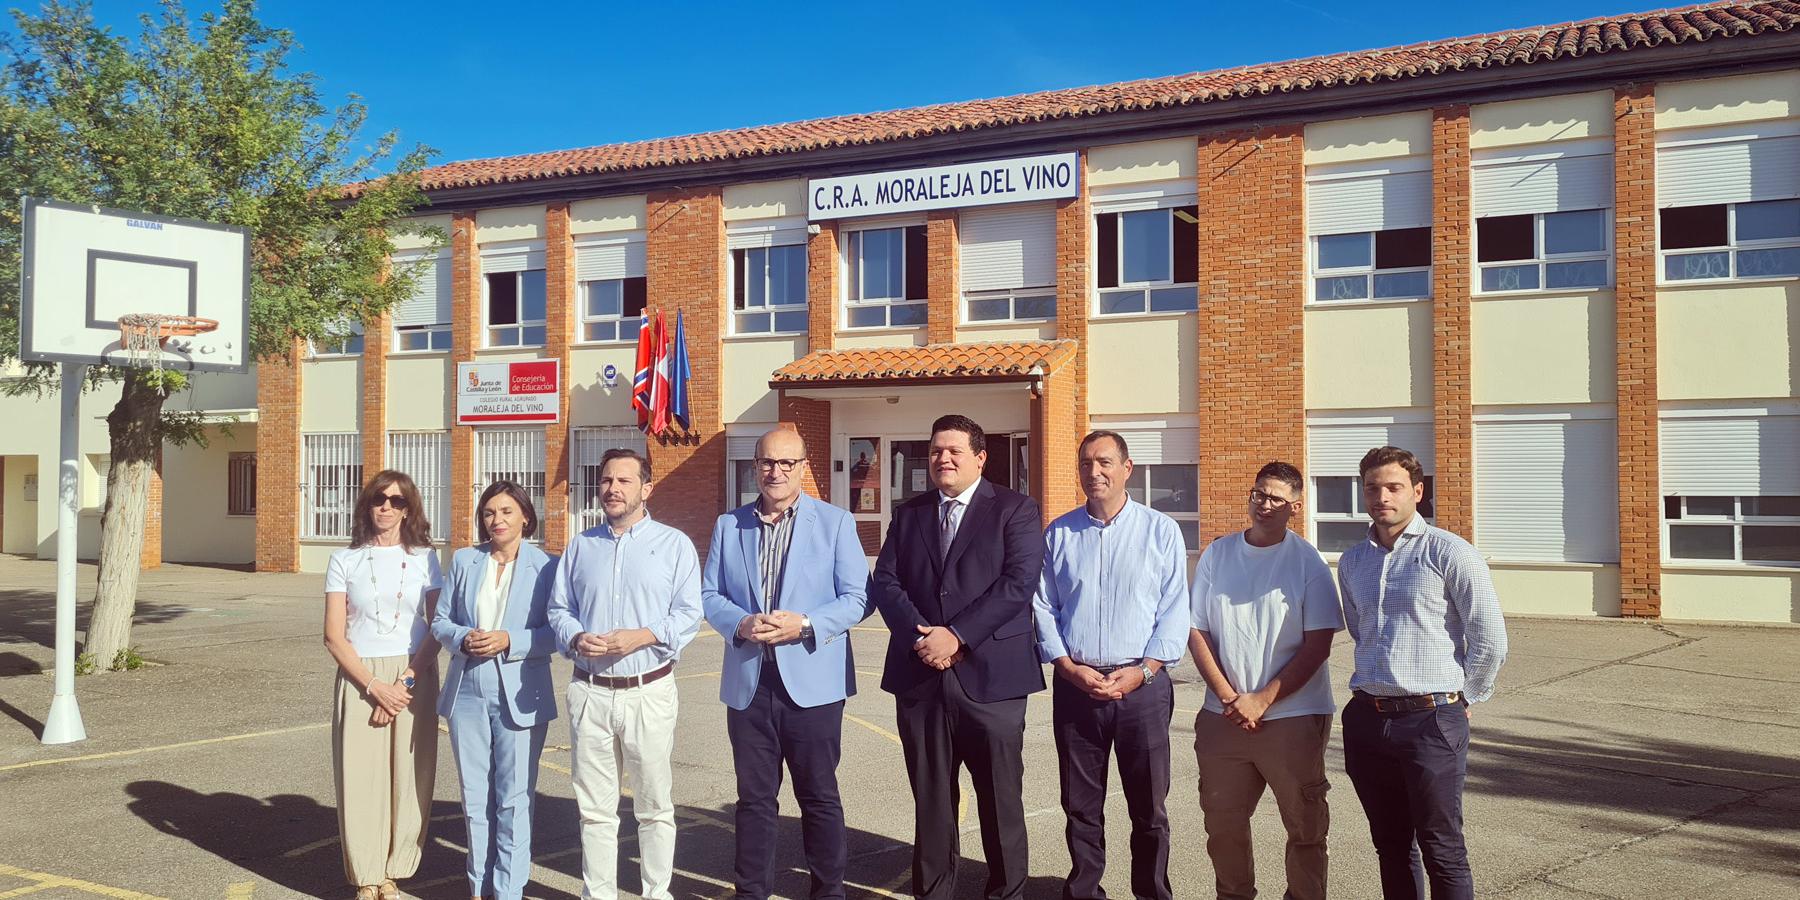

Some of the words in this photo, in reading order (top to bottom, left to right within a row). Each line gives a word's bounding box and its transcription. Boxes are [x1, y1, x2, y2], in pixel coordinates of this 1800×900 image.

[814, 184, 868, 211] C.R.A.
[875, 172, 974, 205] MORALEJA
[980, 168, 1016, 195] DEL
[1022, 162, 1071, 191] VINO
[512, 374, 546, 384] Consejería
[522, 382, 554, 391] Educación
[473, 404, 509, 413] MORALEJA
[511, 404, 524, 412] DEL
[526, 403, 544, 412] VINO
